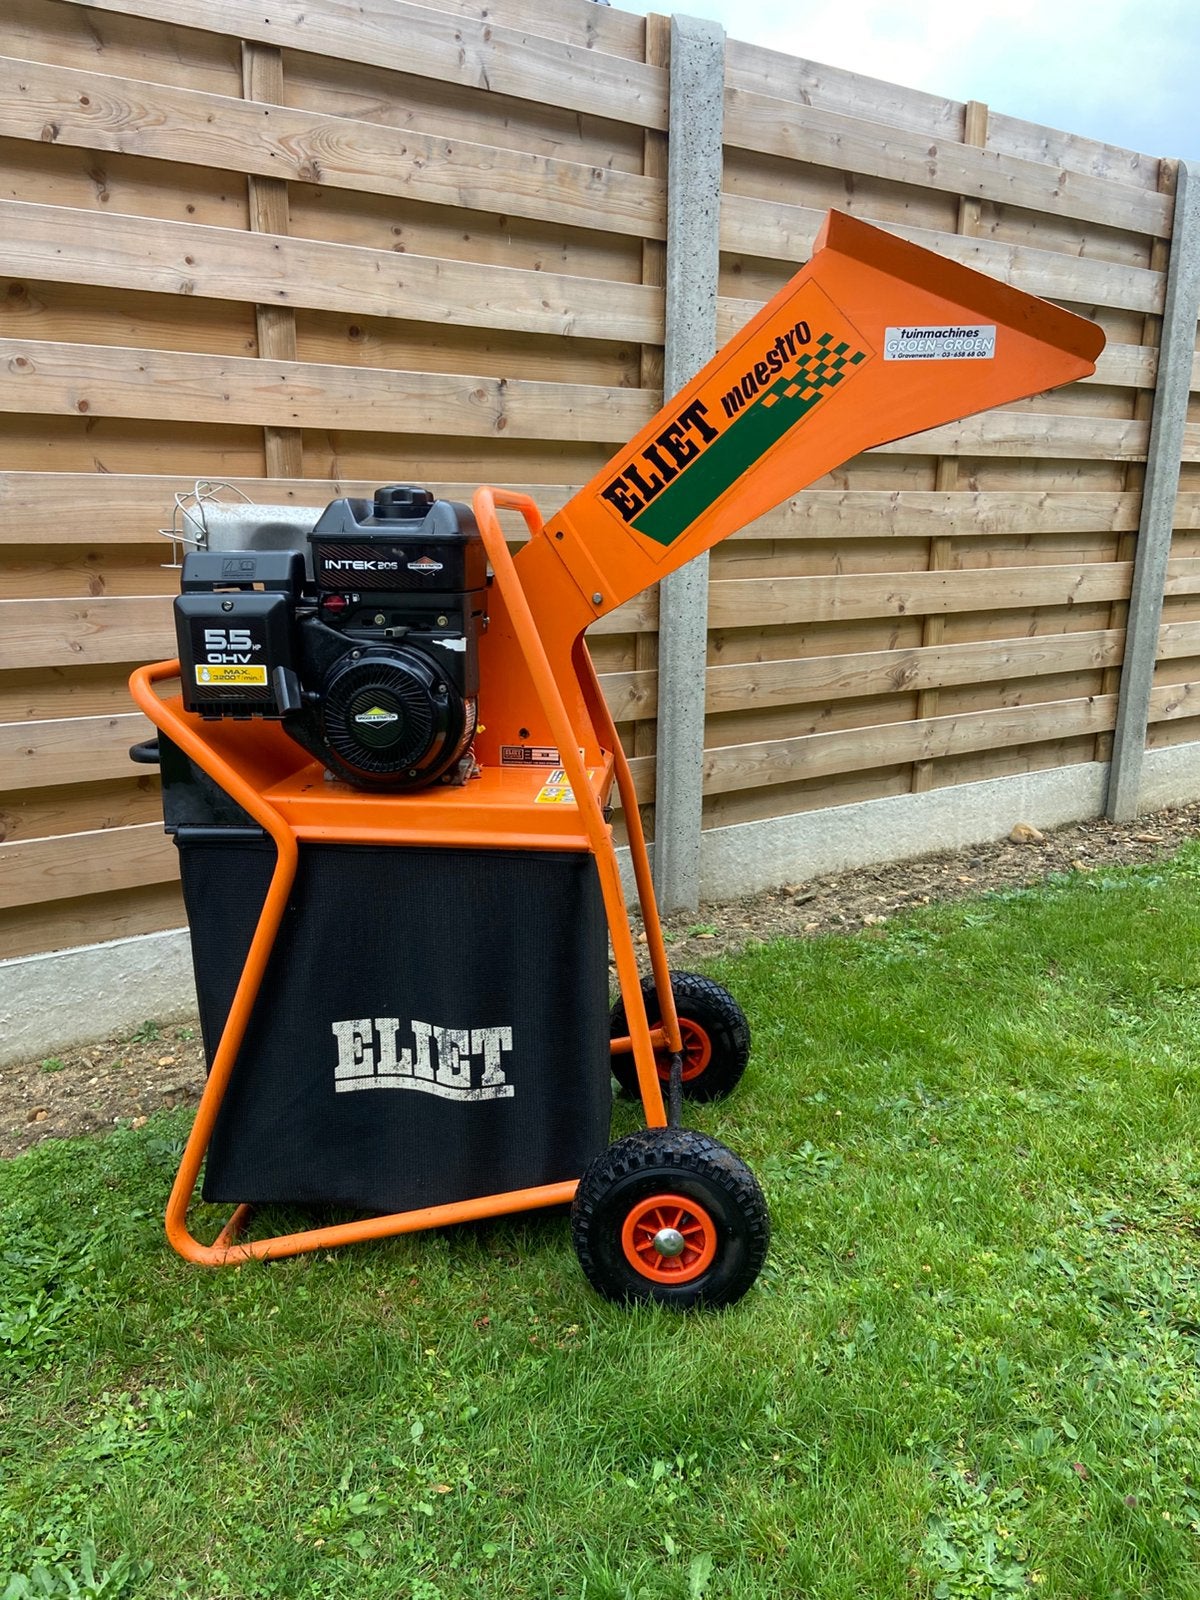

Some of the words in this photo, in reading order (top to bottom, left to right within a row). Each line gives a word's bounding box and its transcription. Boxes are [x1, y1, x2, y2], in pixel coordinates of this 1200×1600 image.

[901, 328, 979, 339] tuinmachines
[887, 339, 994, 352] GROEN-GROEN
[600, 398, 719, 523] ELIET
[720, 320, 811, 418] maestro
[325, 560, 376, 570] INTEK
[204, 629, 252, 650] 5.5
[207, 653, 252, 663] OHV
[331, 1017, 513, 1088] ELIET
